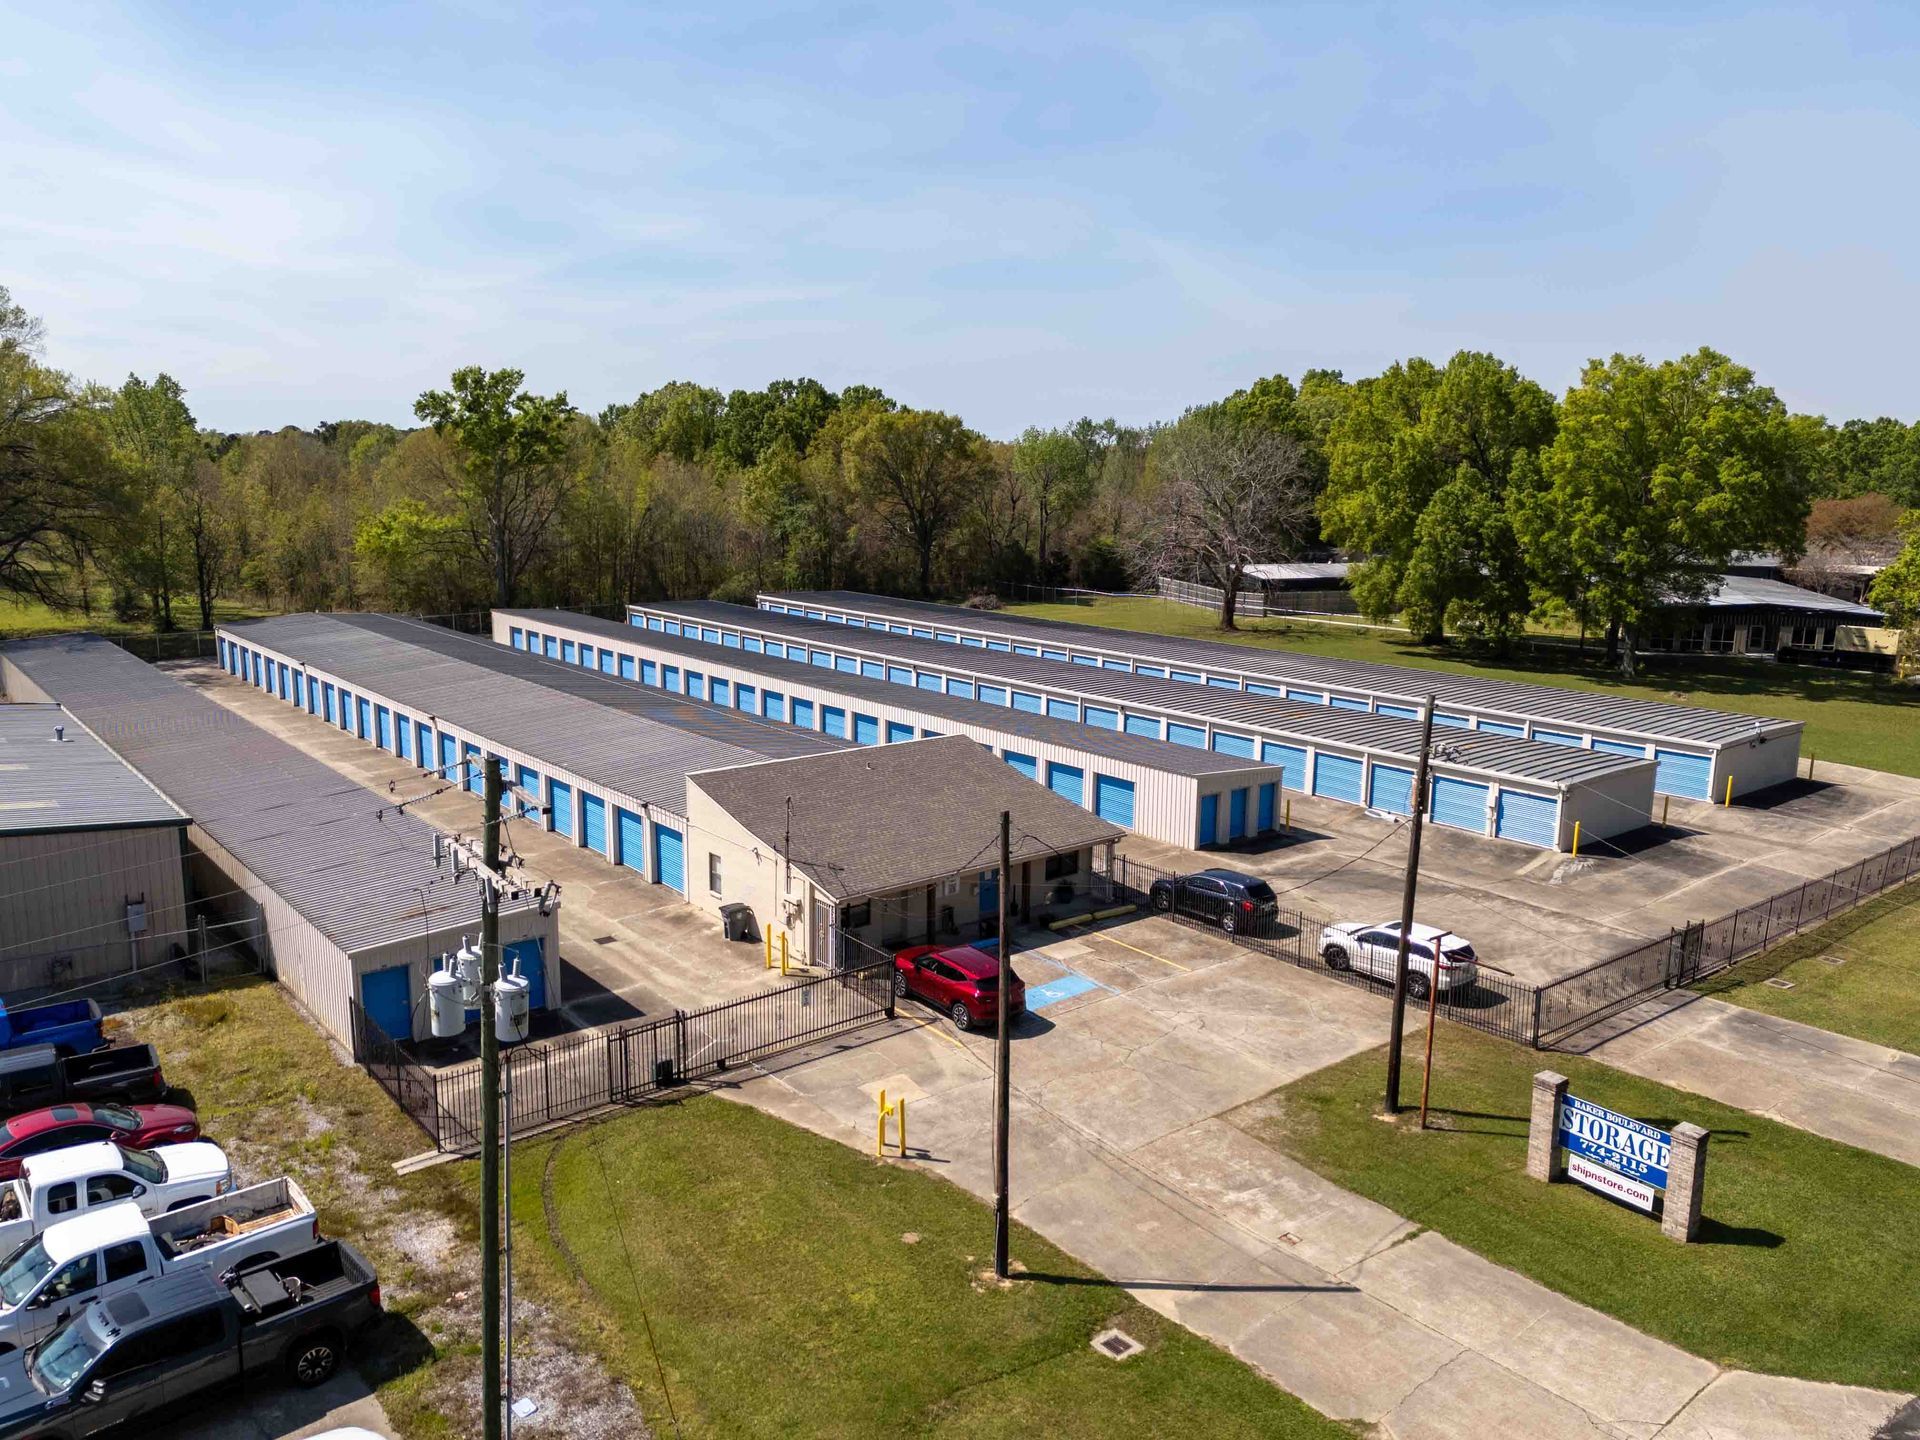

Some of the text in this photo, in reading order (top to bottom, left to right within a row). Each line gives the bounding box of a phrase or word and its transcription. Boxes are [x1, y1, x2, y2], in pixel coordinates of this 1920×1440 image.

[1562, 1108, 1670, 1168] STORAGE
[1574, 1100, 1661, 1140] BAKER BOULEVARD
[1579, 1138, 1648, 1174] 774-2115
[1572, 1163, 1649, 1203] shipnstore.com
